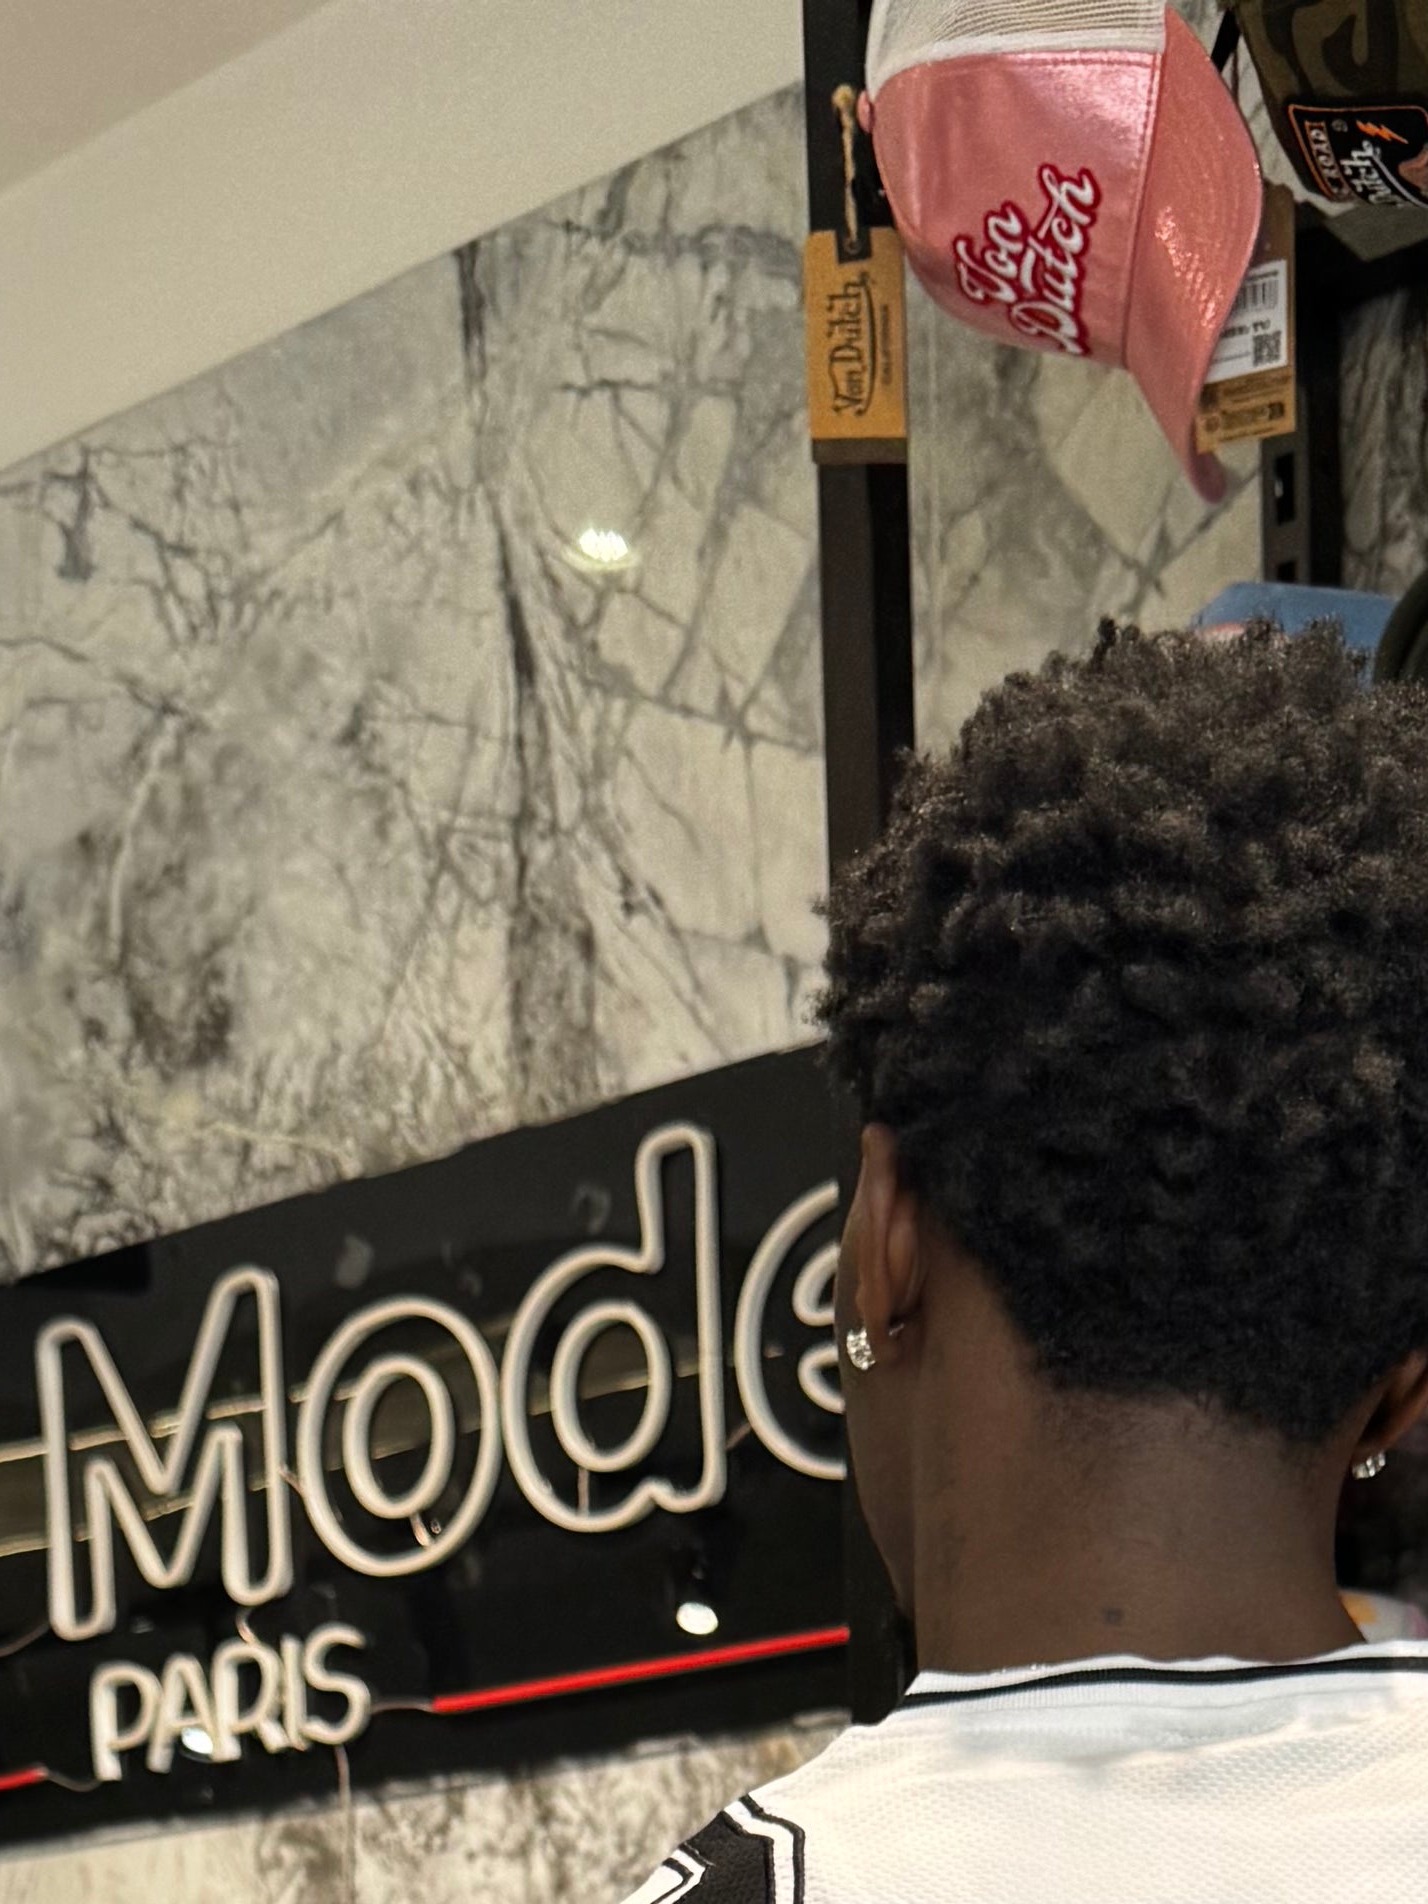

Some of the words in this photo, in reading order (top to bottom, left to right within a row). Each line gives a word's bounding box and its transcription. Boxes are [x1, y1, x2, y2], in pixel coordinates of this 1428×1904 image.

[827, 274, 867, 364] Dutch
[953, 200, 1025, 307] Von
[1008, 163, 1103, 355] Dutch
[90, 1622, 373, 1783] PARIS
